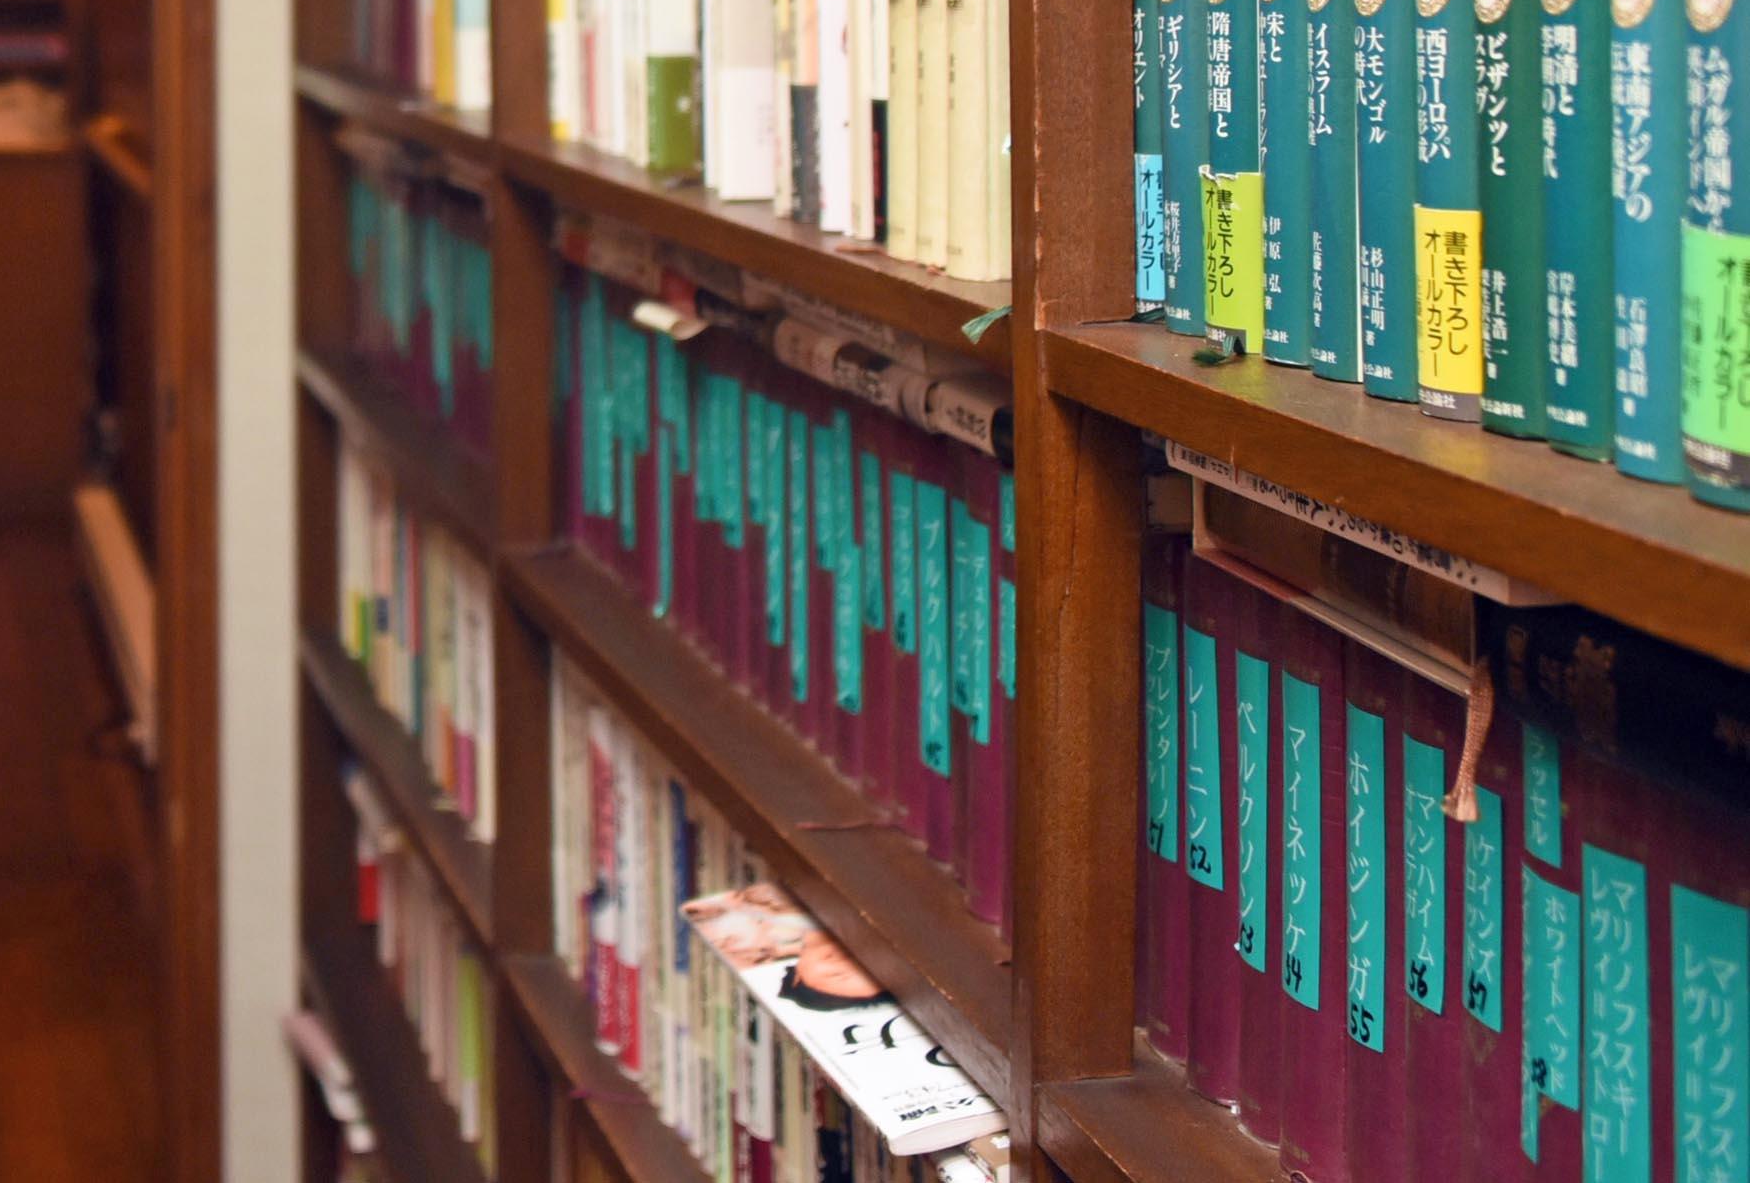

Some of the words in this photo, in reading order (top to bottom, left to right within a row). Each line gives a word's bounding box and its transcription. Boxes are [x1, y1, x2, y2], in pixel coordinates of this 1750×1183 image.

[1167, 15, 1184, 129] ギリシアと
[1212, 12, 1232, 138] 隋唐帝国と
[1266, 11, 1285, 64] 宋と
[1314, 22, 1333, 136] イスラーム
[1365, 26, 1388, 144] 大モンゴル
[1426, 29, 1451, 161] 西ヨーロッパ
[1487, 33, 1508, 177] ビザンツと
[1626, 42, 1653, 223] 東南アジアの
[1141, 171, 1155, 292] オールカラー
[1205, 187, 1217, 317] オールカラー
[1217, 189, 1234, 299] 書き下ろし
[1370, 246, 1385, 331] 杉山正明
[1444, 231, 1469, 356] 書き下ろし
[1425, 229, 1443, 378] オールカラー
[1715, 257, 1737, 431] オールカラー
[1186, 665, 1208, 841] レーニン
[1287, 725, 1306, 956] マイネッケ
[1348, 750, 1371, 1001] ホイジンガ
[1417, 793, 1438, 966] マンハイム
[1349, 1002, 1375, 1044] 55
[1409, 961, 1429, 999] 56
[1545, 897, 1566, 1093] ホワイトヘッド
[1610, 877, 1638, 1156] マリノフスキー
